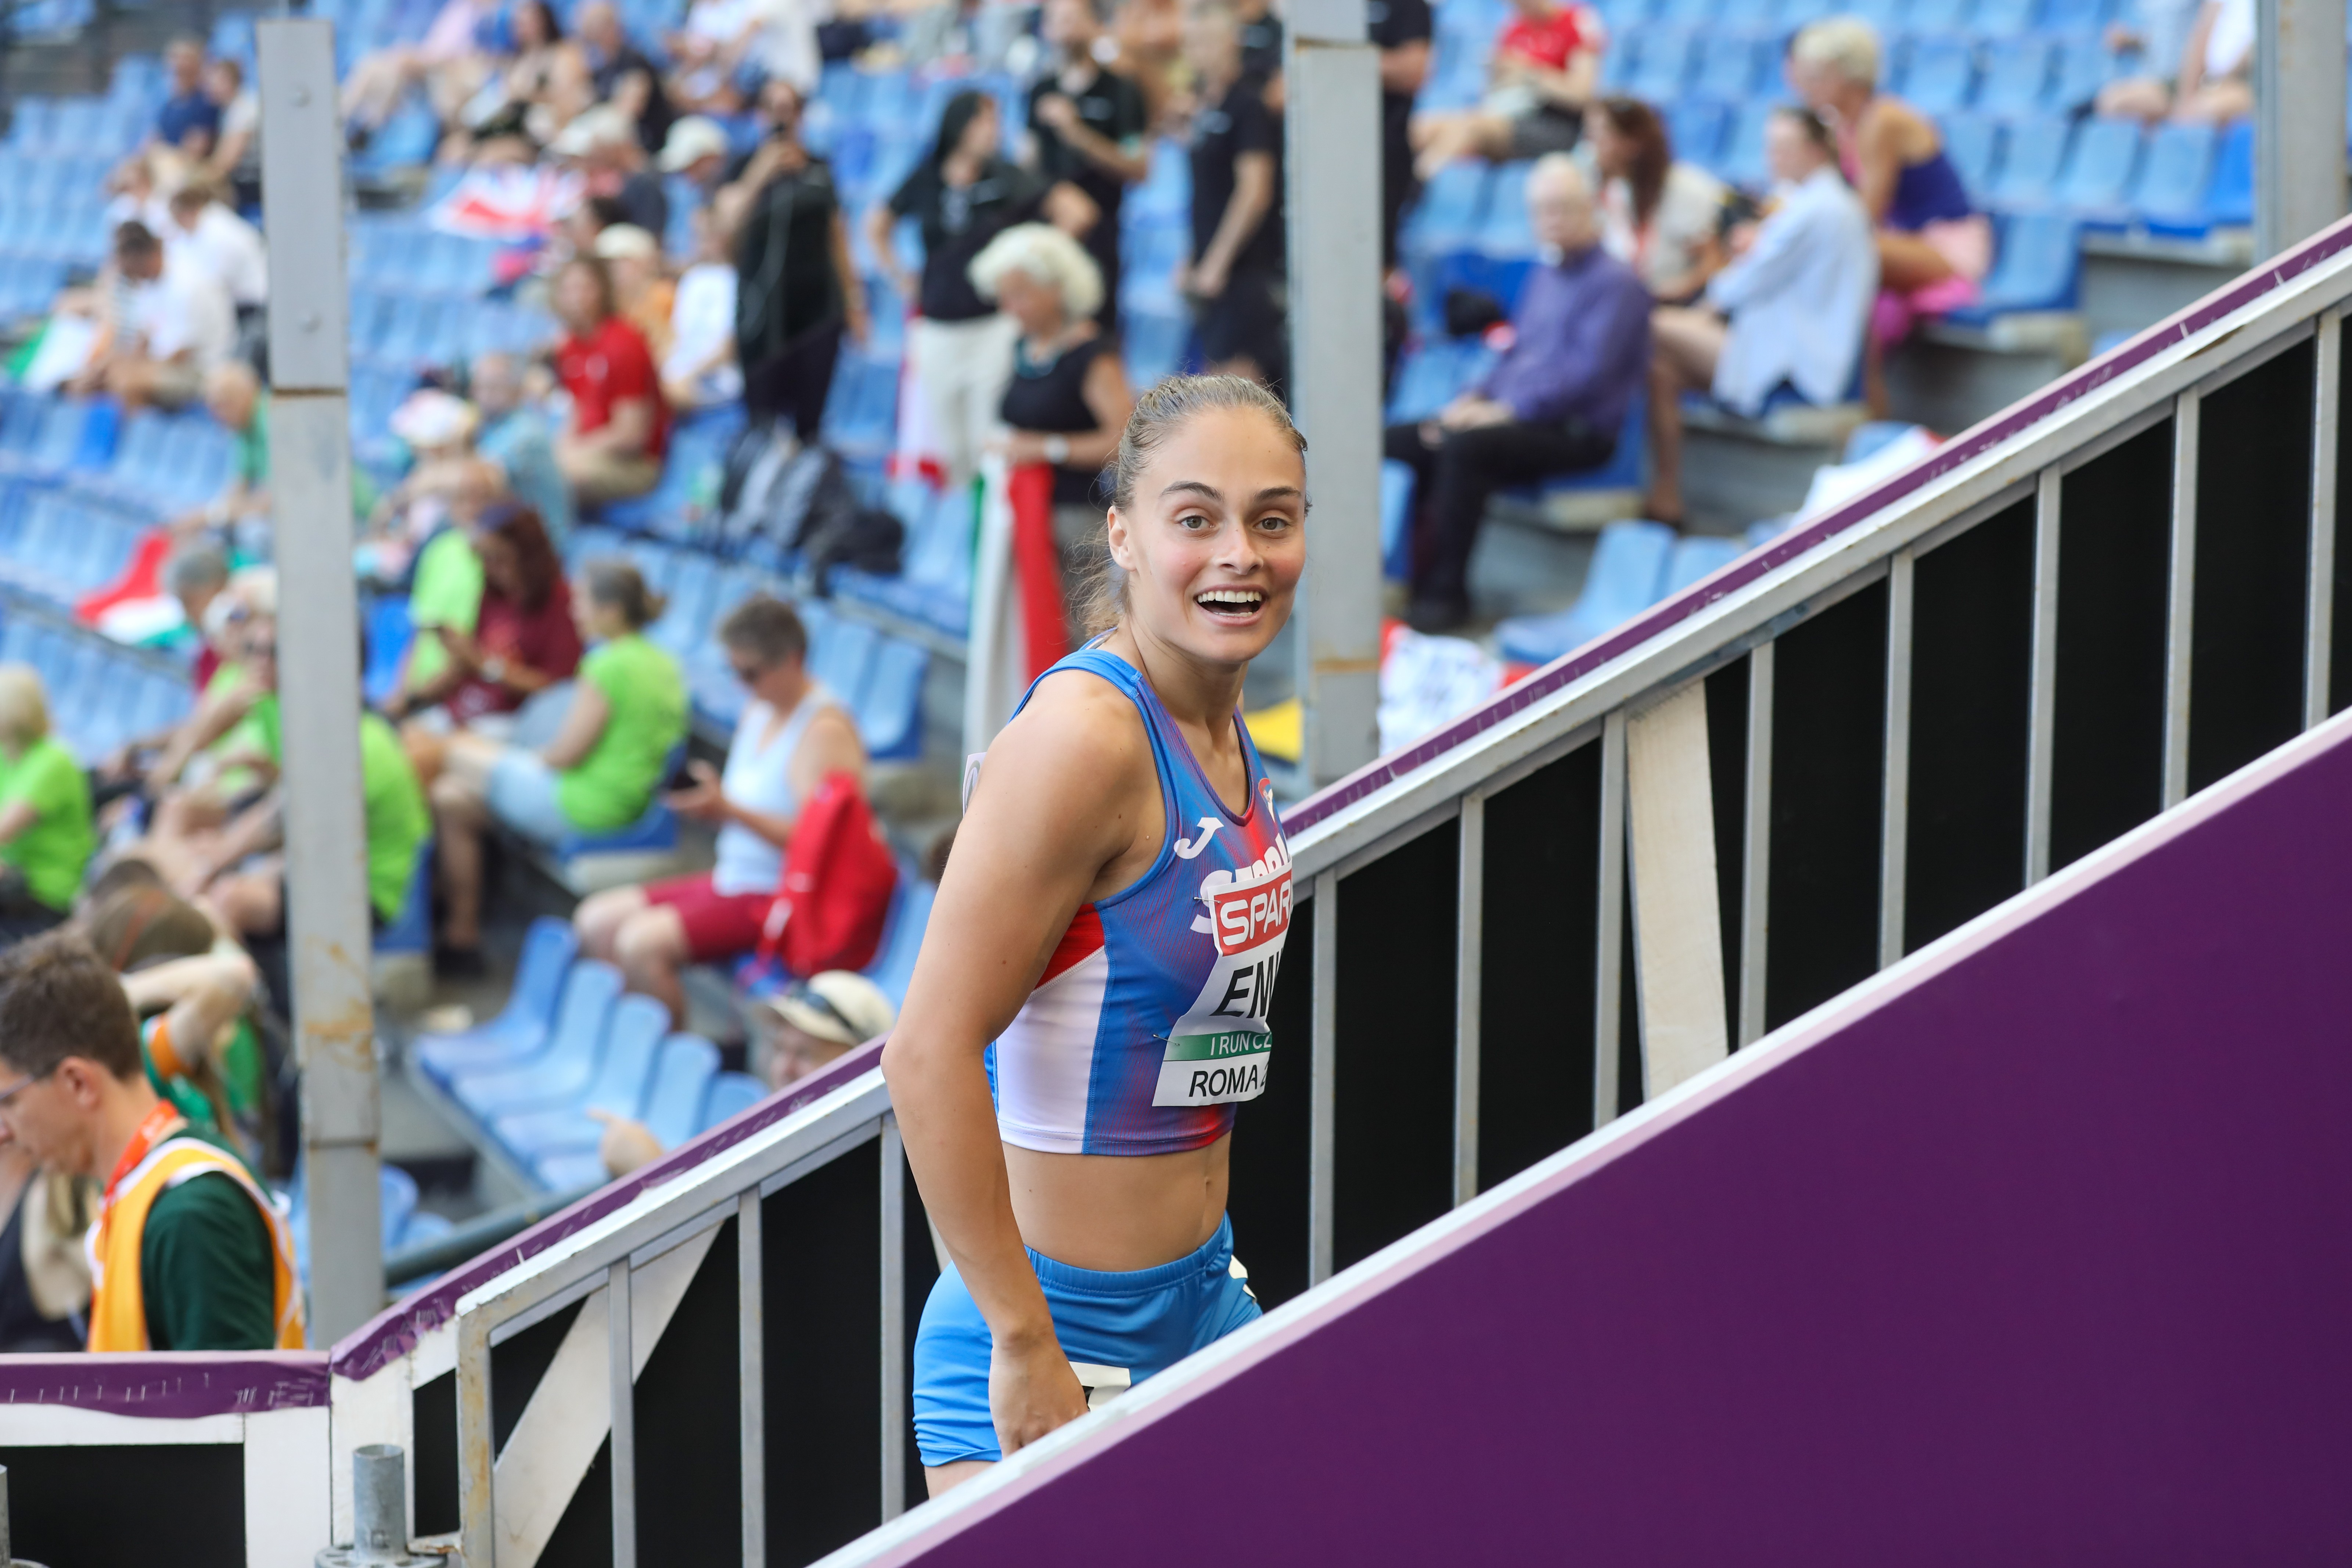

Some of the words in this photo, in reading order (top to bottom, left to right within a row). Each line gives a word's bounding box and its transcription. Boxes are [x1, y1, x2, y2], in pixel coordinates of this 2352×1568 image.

[1220, 879, 1291, 946] SPAR
[1210, 1037, 1215, 1056] I
[1218, 1033, 1251, 1055] RUN
[1188, 1064, 1258, 1098] ROMA
